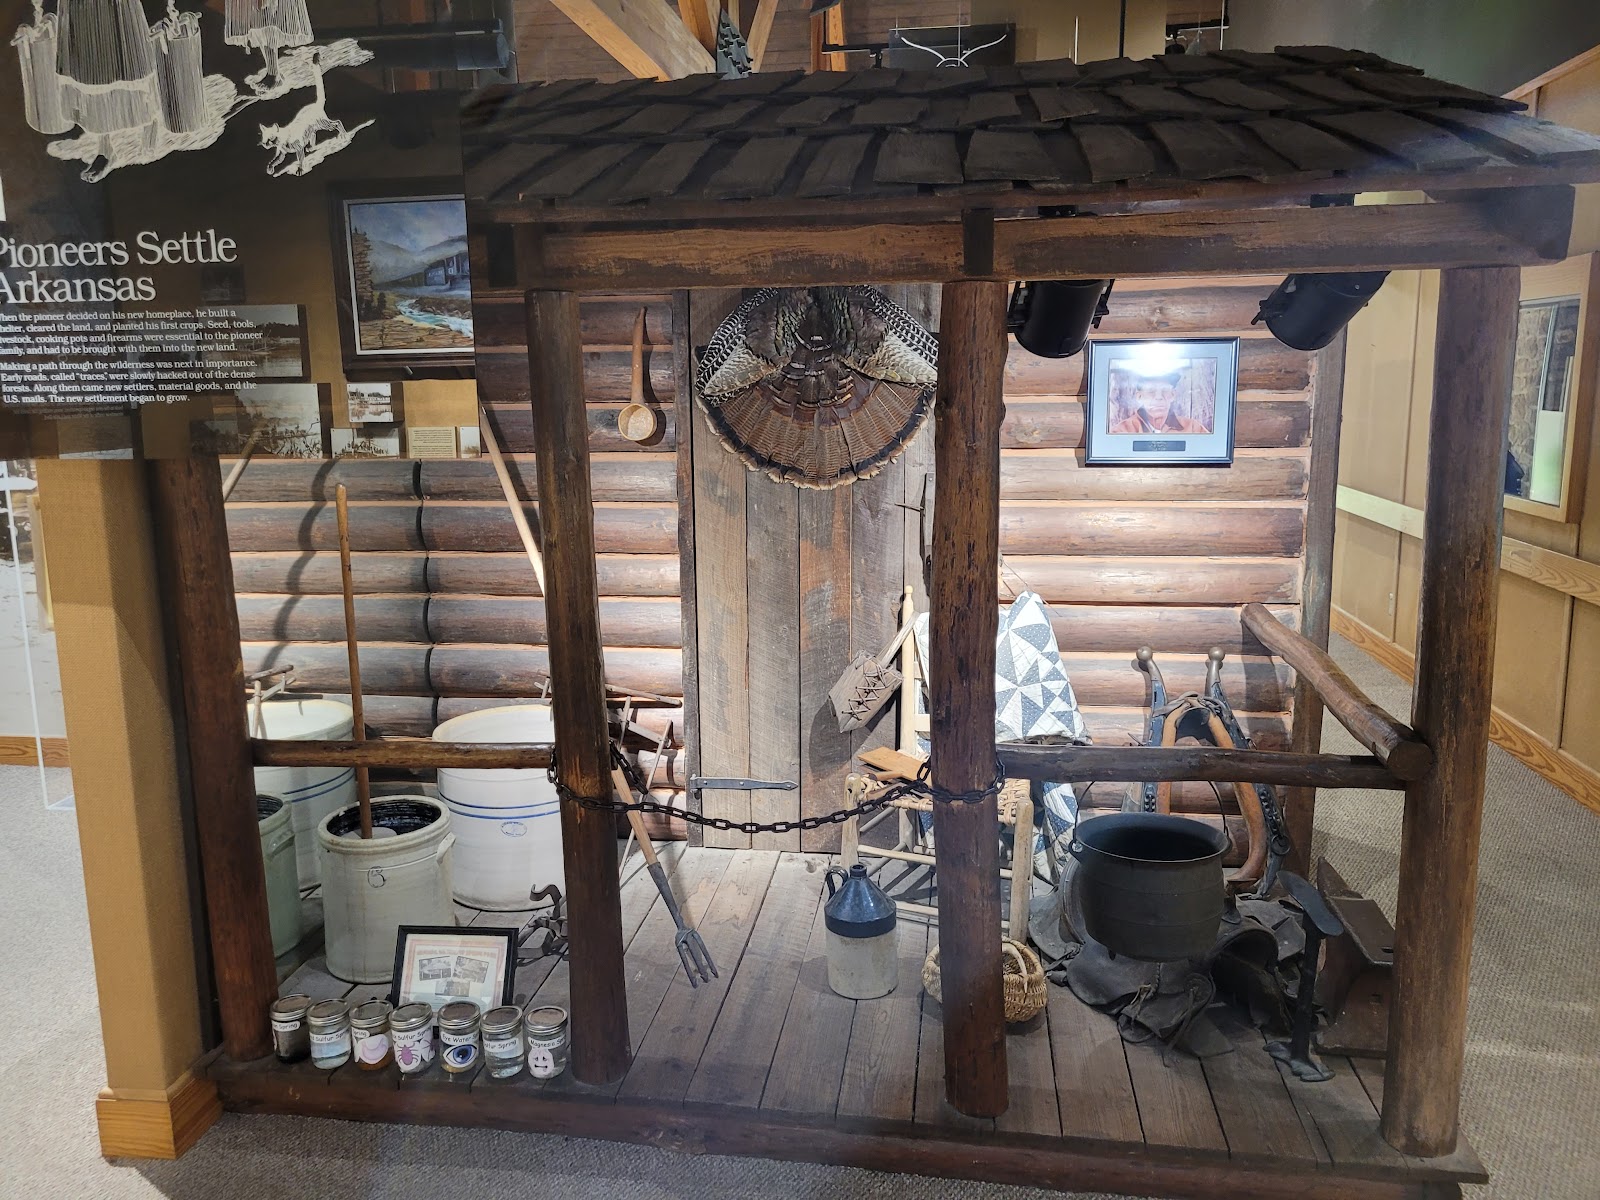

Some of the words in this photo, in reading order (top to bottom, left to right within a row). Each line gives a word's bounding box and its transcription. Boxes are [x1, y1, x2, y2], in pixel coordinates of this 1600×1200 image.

[136, 229, 238, 265] Settle
[0, 270, 157, 304] Arkansas
[19, 312, 33, 321] the
[33, 313, 64, 323] pioneer
[66, 311, 98, 320] decided
[112, 311, 125, 319] his
[196, 309, 206, 317] he
[208, 309, 229, 317] built
[26, 323, 56, 332] cleared
[57, 323, 71, 331] the
[95, 322, 111, 331] and
[113, 322, 144, 332] planted
[146, 321, 159, 329] his
[161, 321, 178, 329] first
[35, 335, 69, 345] cooking
[70, 334, 88, 344] pots
[89, 334, 105, 342] and
[107, 333, 142, 341] firearms
[144, 333, 164, 341] were
[165, 332, 202, 340] essential
[204, 332, 213, 340] to
[231, 331, 263, 341] pioneer
[27, 346, 42, 354] and
[43, 346, 60, 354] had
[62, 346, 70, 354] to
[71, 345, 82, 353] be
[83, 345, 116, 355] brought
[118, 344, 137, 352] with
[139, 344, 160, 352] them
[163, 343, 179, 351] into
[181, 343, 195, 351] the
[0, 362, 30, 372] Making
[39, 362, 58, 372] path
[59, 361, 93, 371] through
[95, 361, 108, 369] the
[110, 361, 154, 369] wilderness
[1, 373, 23, 383] Early
[51, 373, 75, 381] called
[131, 371, 155, 381] slowly
[157, 371, 188, 379] hacked
[189, 371, 203, 379] out
[205, 370, 214, 378] of
[215, 370, 229, 378] the
[231, 370, 256, 378] dense
[33, 384, 58, 394] Along
[59, 384, 81, 392] them
[82, 384, 104, 392] came
[158, 382, 194, 390] material
[225, 382, 241, 390] and
[243, 381, 257, 389] the
[48, 394, 65, 403] The
[85, 394, 128, 402] settlement
[130, 393, 155, 404] began
[157, 394, 165, 402] to
[442, 1033, 451, 1041] Eye
[452, 1035, 471, 1043] Water
